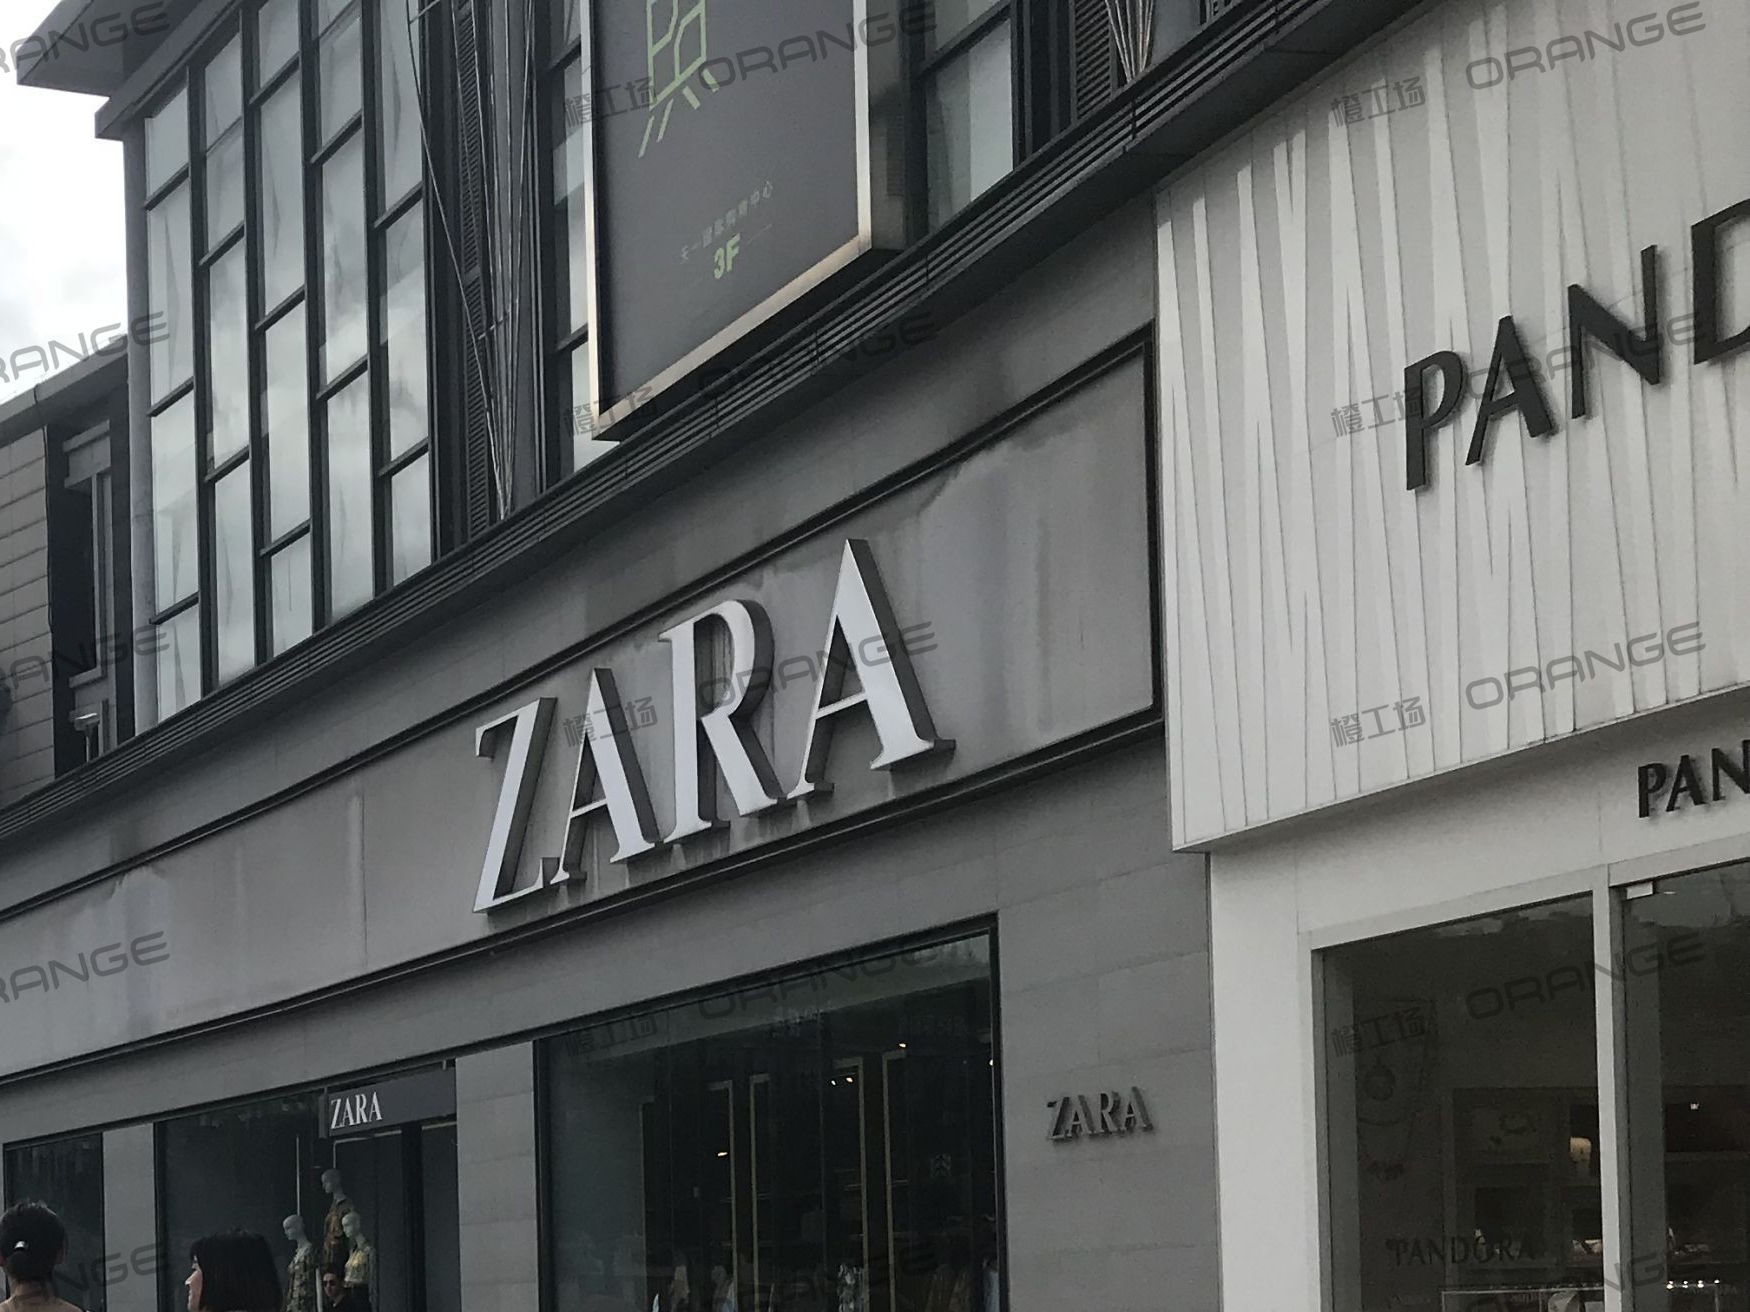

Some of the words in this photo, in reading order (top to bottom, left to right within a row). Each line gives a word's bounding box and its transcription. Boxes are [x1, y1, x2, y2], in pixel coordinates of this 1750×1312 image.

[714, 233, 741, 280] 3F
[473, 539, 956, 913] ZARA
[331, 1092, 382, 1129] ZARA
[1047, 1086, 1154, 1140] ZARA
